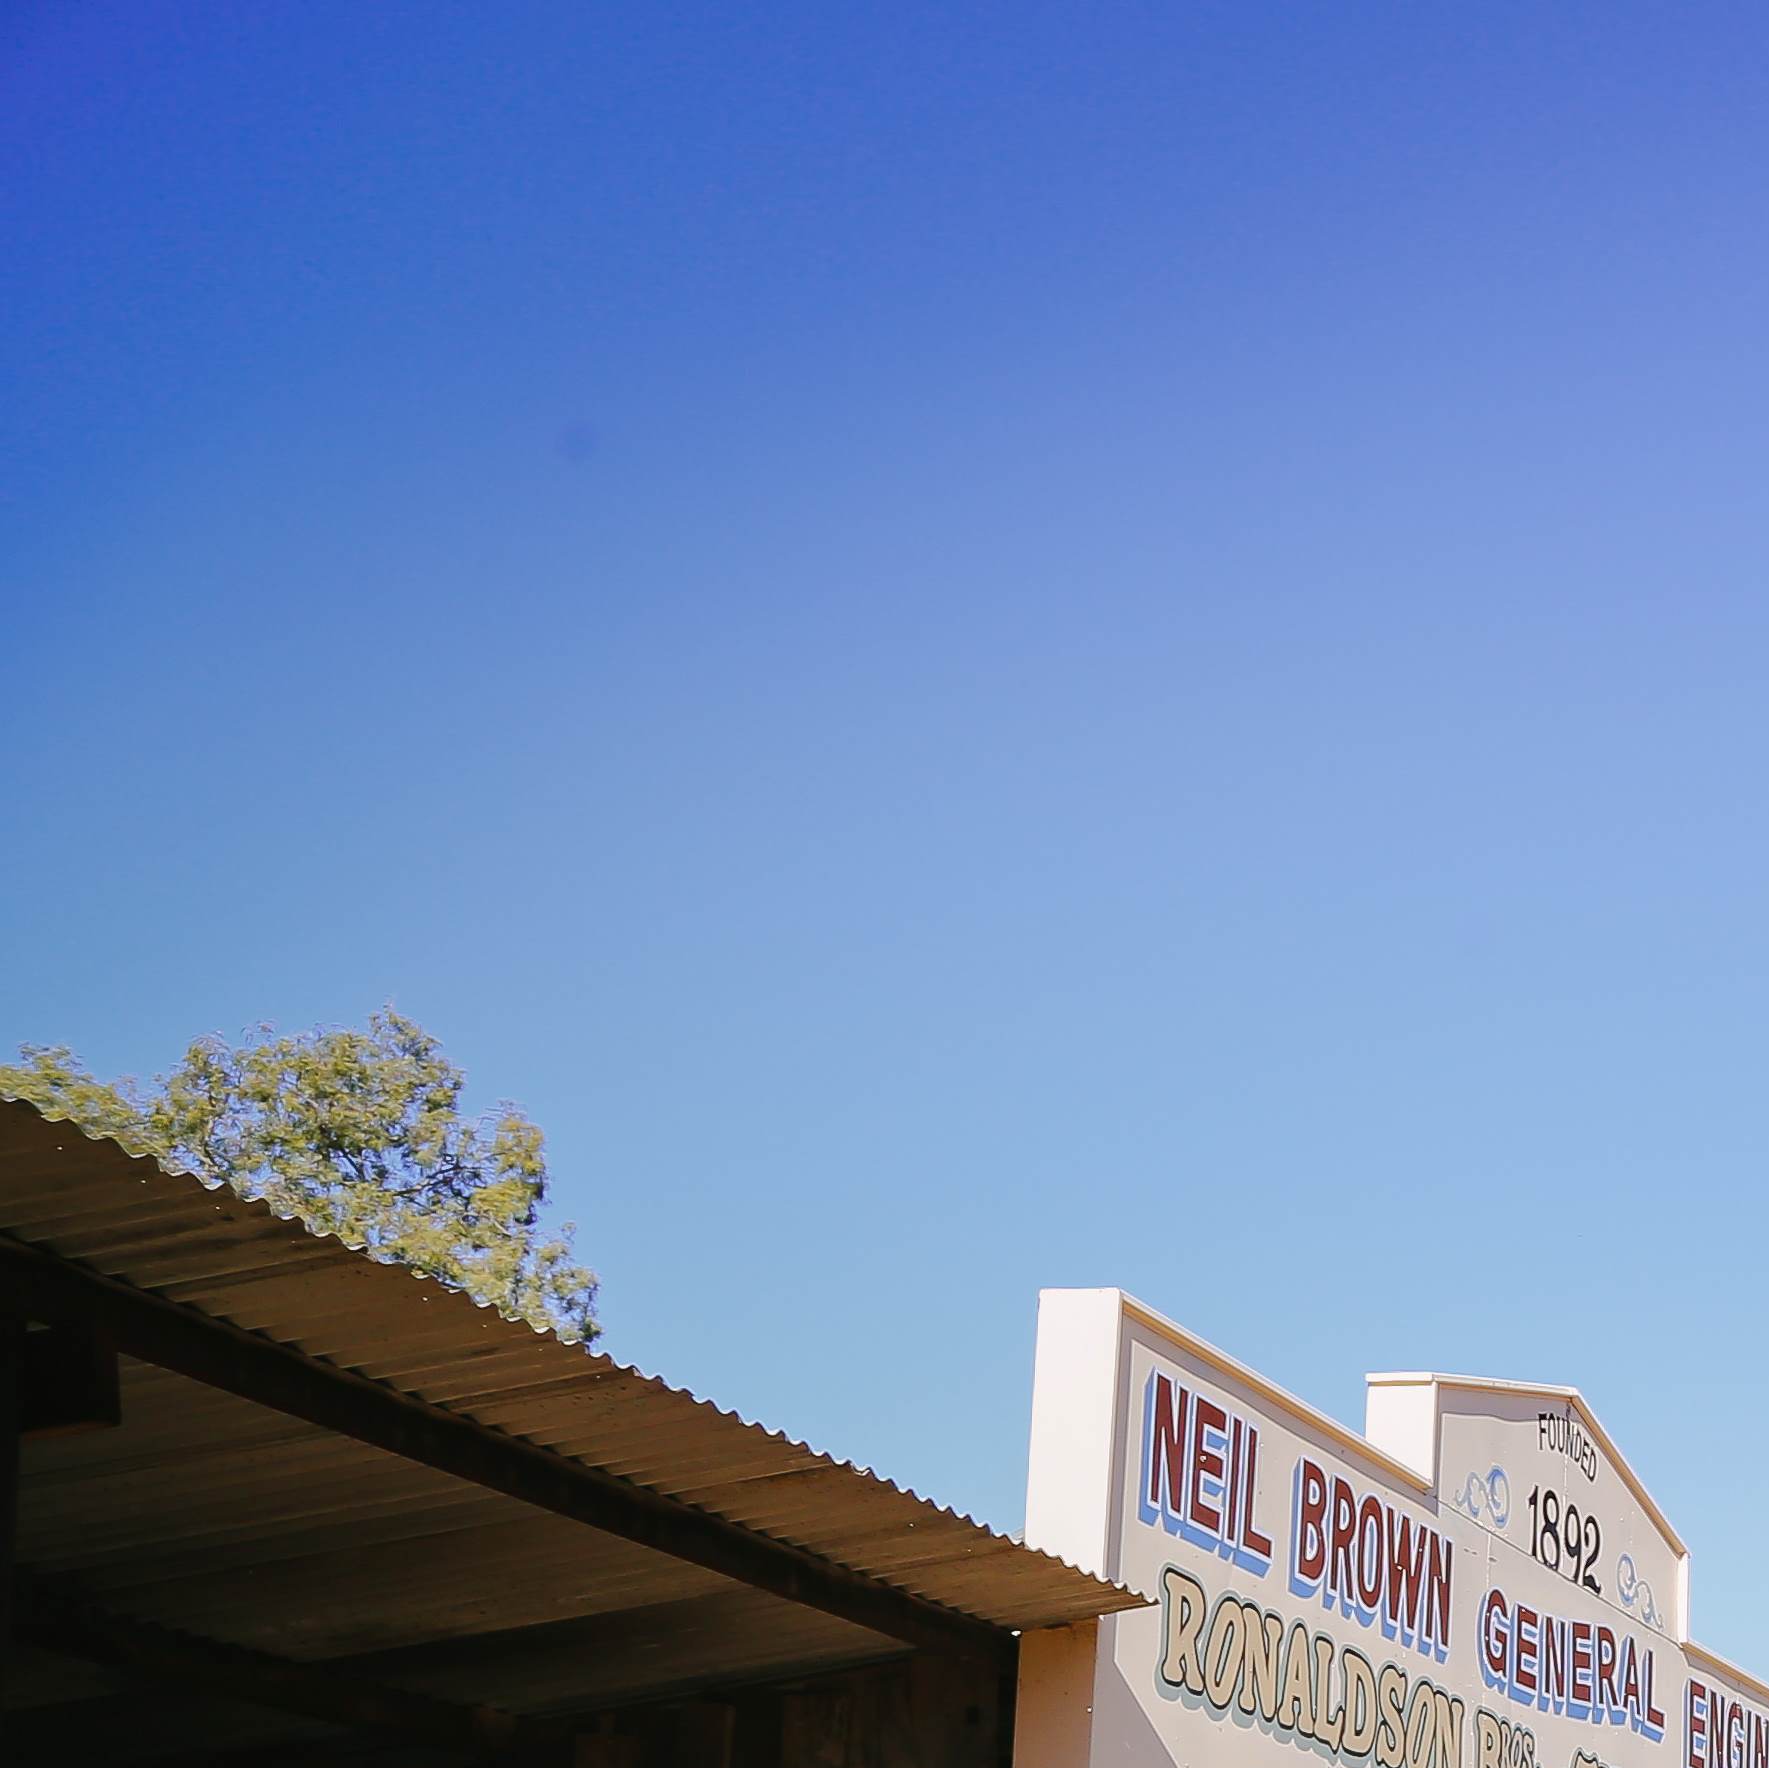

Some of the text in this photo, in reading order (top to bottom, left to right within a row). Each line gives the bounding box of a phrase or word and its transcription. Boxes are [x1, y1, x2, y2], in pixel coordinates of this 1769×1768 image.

[1537, 1412, 1598, 1483] FOUNDED
[1142, 1369, 1273, 1564] NEIL
[1294, 1456, 1454, 1657] BROWN
[1481, 1588, 1665, 1737] GENERAL
[1527, 1484, 1601, 1595] 1892
